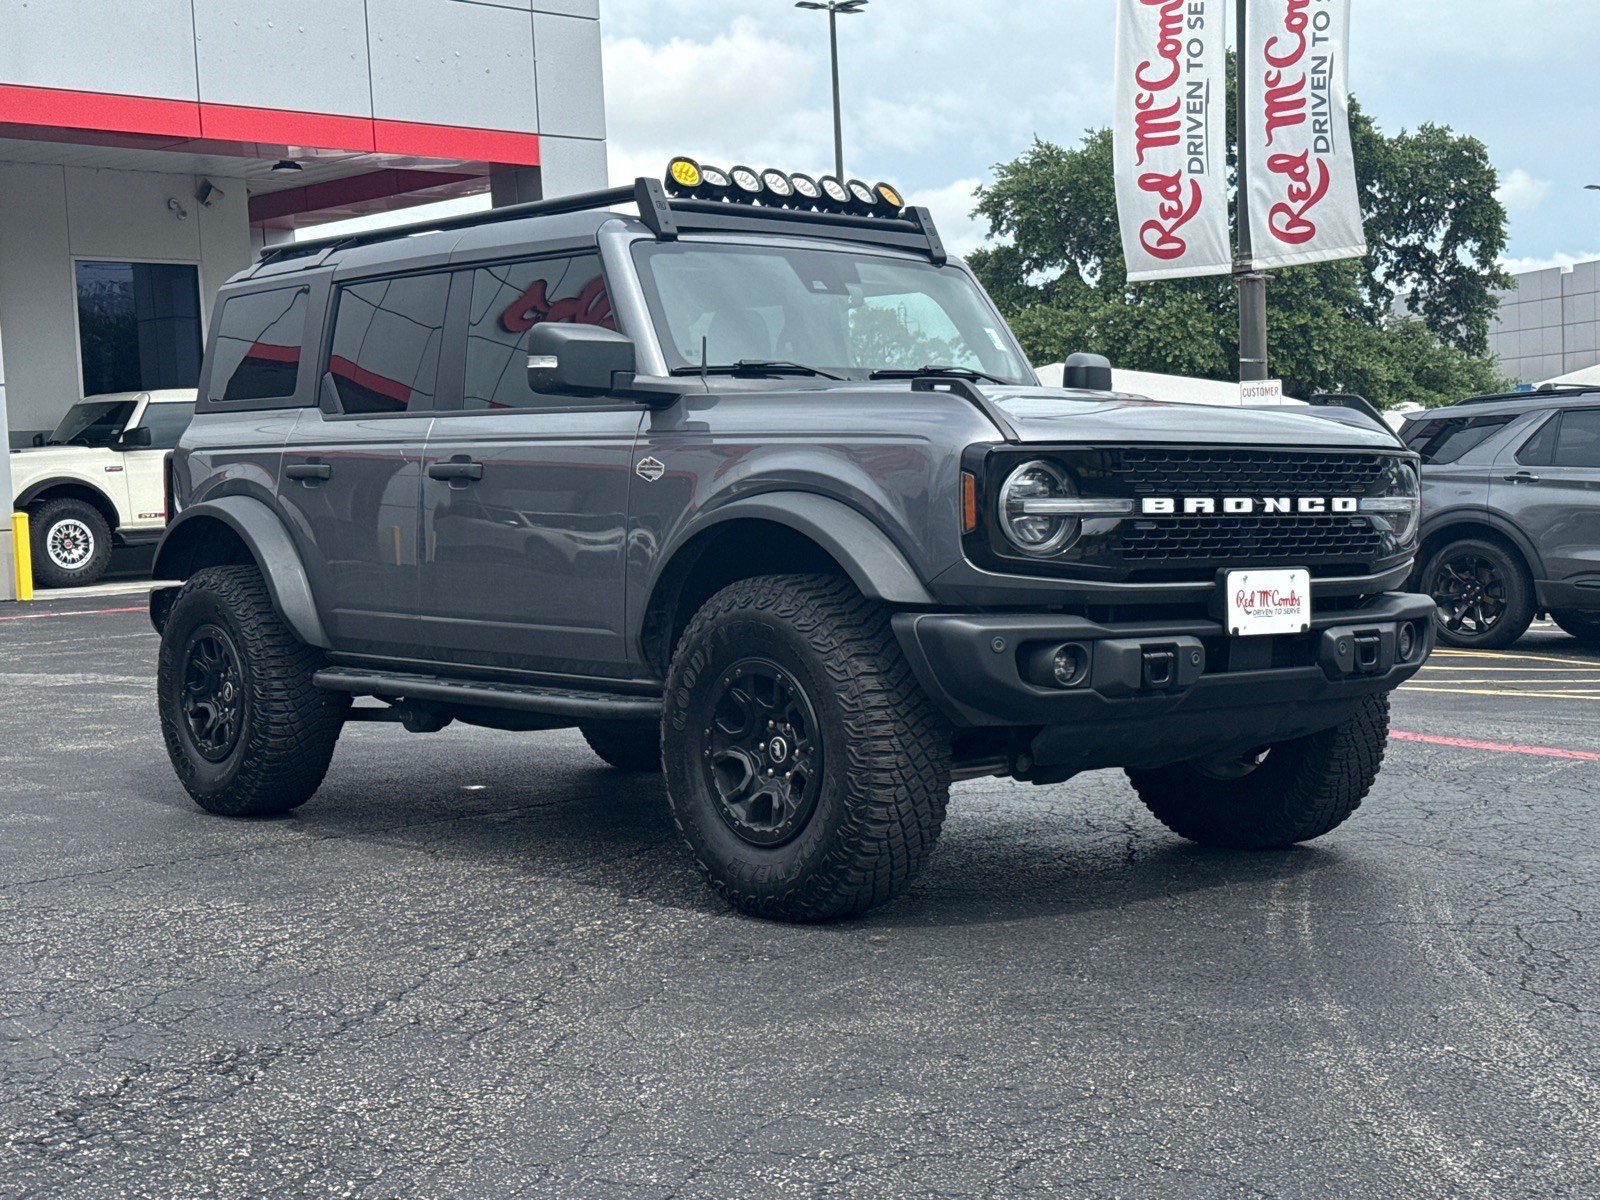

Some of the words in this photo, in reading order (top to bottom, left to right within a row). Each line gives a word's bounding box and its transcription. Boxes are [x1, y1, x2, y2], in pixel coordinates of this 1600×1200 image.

[1187, 37, 1204, 74] TO
[1312, 10, 1331, 48] TO
[1135, 0, 1184, 166] McCom
[1311, 55, 1331, 154] DRIVEN
[1187, 81, 1205, 175] DRIVEN
[1138, 169, 1203, 259] Red
[1267, 148, 1330, 244] Red
[1242, 386, 1279, 398] CUSTOMER
[1142, 497, 1357, 514] BRONCO
[1236, 589, 1255, 615] Red
[1257, 589, 1301, 607] McCombs
